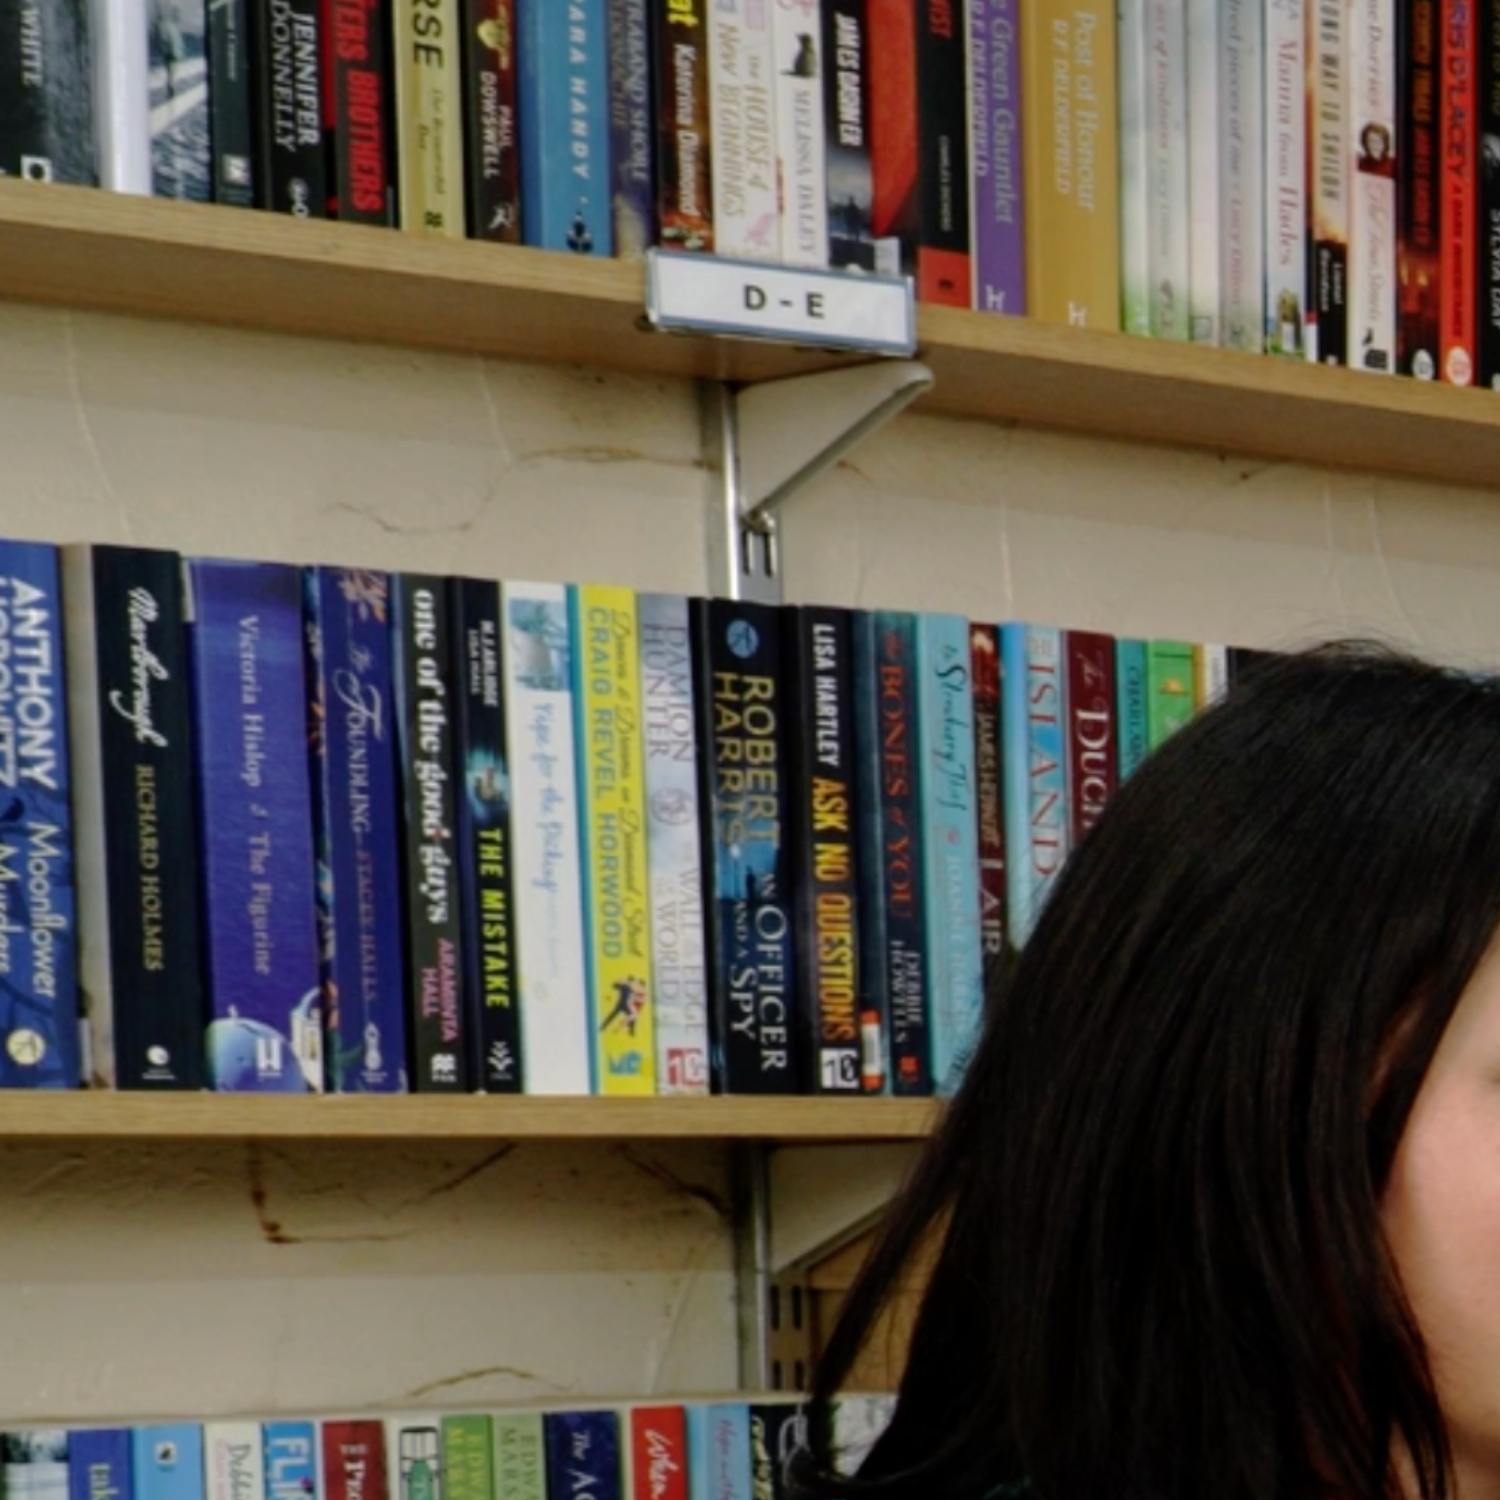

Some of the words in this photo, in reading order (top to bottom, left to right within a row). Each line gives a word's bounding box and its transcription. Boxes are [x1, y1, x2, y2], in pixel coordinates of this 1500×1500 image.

[21, 7, 43, 88] WHITE
[295, 14, 320, 146] JENNIFER
[347, 68, 387, 213] BROTHERS
[480, 70, 500, 179] DOWSWELL
[497, 104, 514, 150] PAUL
[569, 76, 591, 180] HANDY
[805, 292, 824, 318] E
[238, 614, 260, 704] Victoria
[412, 589, 434, 649] one
[586, 603, 616, 696] CRAIG
[812, 623, 837, 669] LISA
[12, 579, 59, 790] ANTHONY
[108, 587, 170, 748] Marlborough
[416, 657, 447, 696] of
[242, 712, 266, 788] Hislop
[417, 701, 446, 752] the
[592, 705, 617, 800] REVEL
[714, 670, 747, 846] HARRIS
[741, 674, 780, 842] ROBERT
[814, 675, 841, 766] HARTLEY
[135, 764, 158, 870] RICHARD
[413, 761, 452, 838] good
[812, 776, 849, 831] ASK
[1027, 663, 1062, 879] ISLAND
[248, 832, 271, 881] The
[422, 844, 453, 923] guys
[479, 827, 502, 877] THE
[600, 810, 625, 962] HORWOOD
[812, 843, 849, 882] NO
[26, 822, 67, 998] Moonflower
[140, 875, 163, 971] HOLMES
[249, 882, 275, 976] Figurine
[485, 888, 511, 1009] MISTAKE
[421, 967, 442, 1018] HALL
[438, 938, 459, 1042] ARAMINTA
[815, 893, 858, 1041] QUESTIONS
